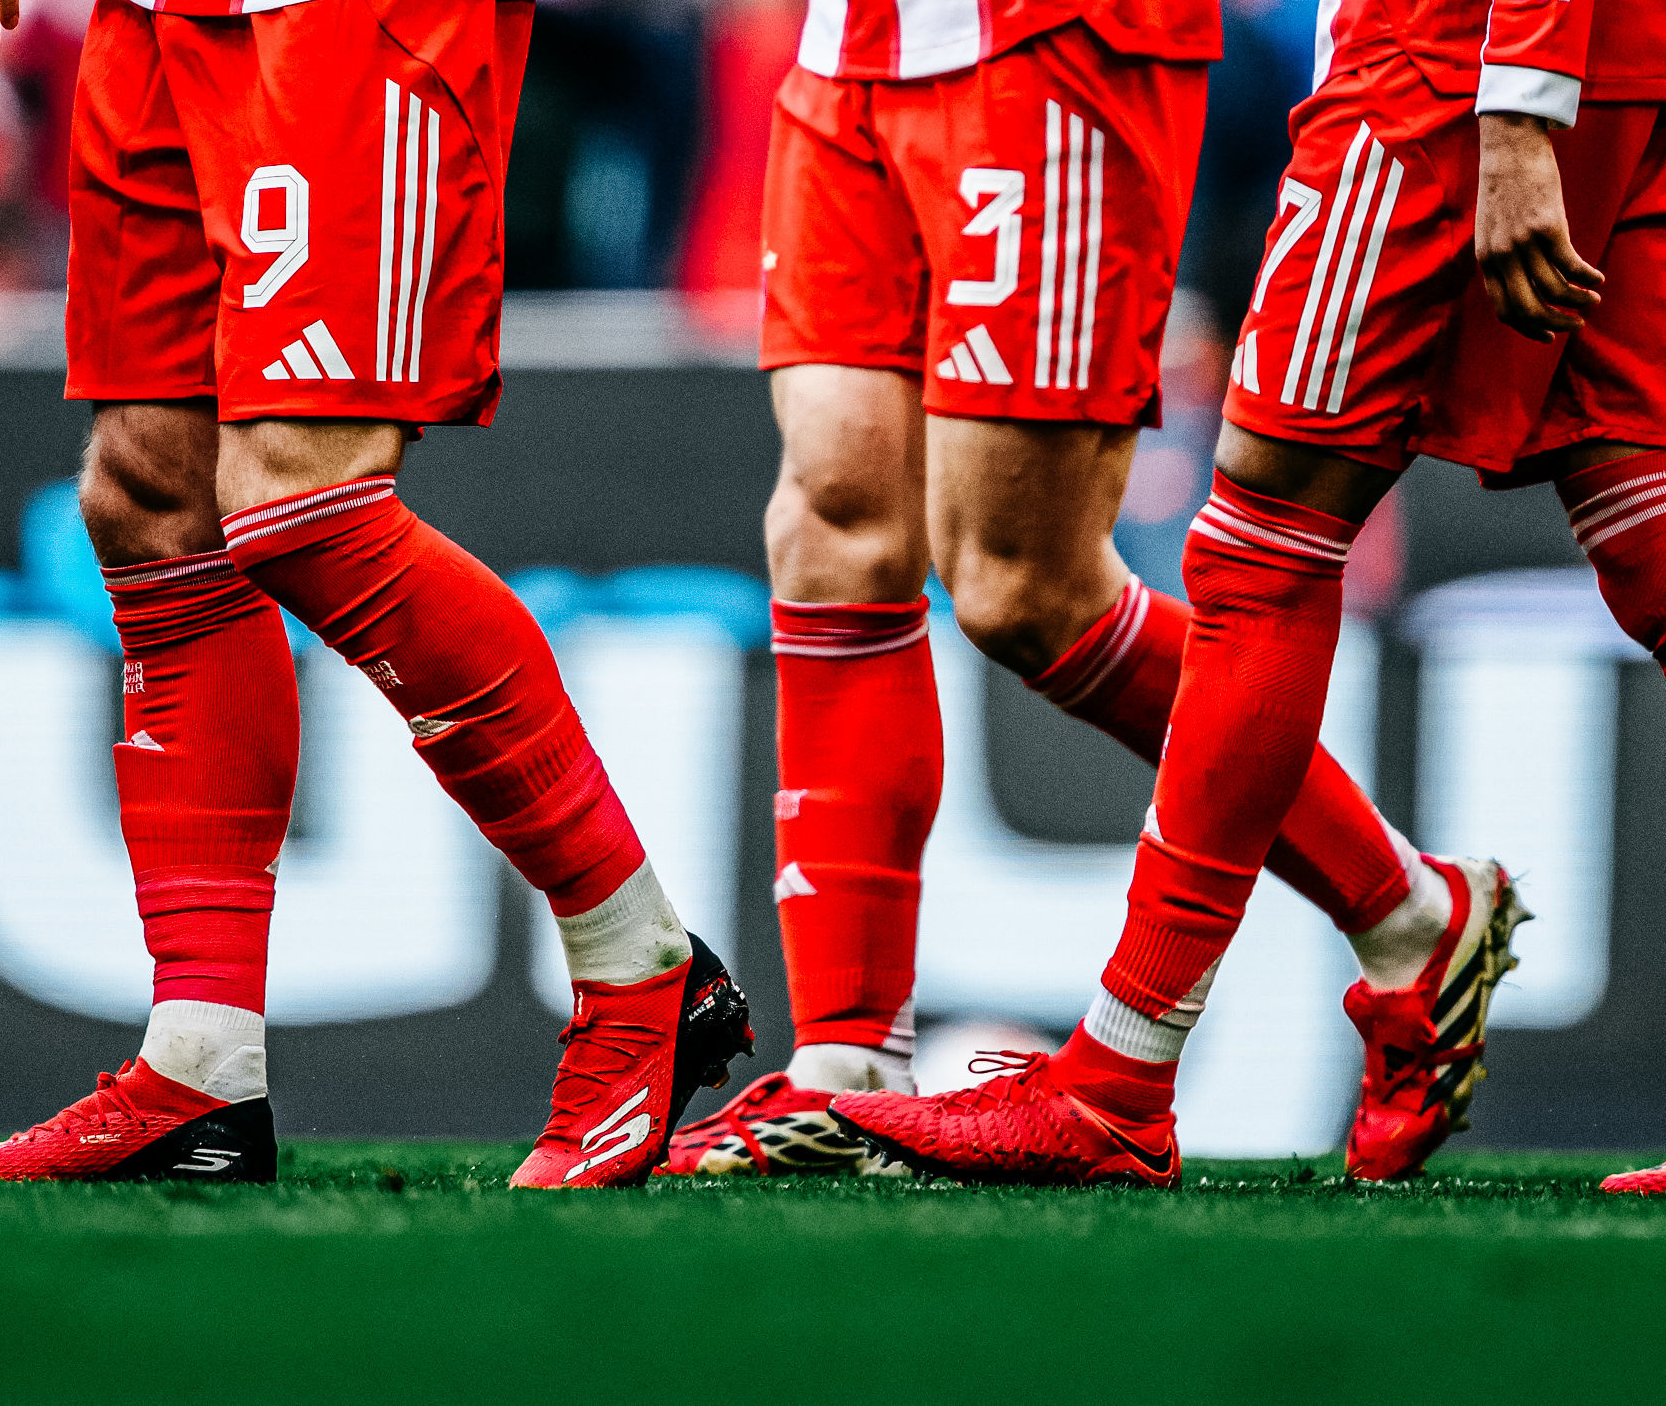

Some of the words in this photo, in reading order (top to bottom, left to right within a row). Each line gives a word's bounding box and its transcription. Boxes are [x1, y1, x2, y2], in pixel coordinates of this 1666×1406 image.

[240, 164, 310, 309] 9
[945, 167, 1025, 306] 3
[1252, 176, 1323, 314] 7
